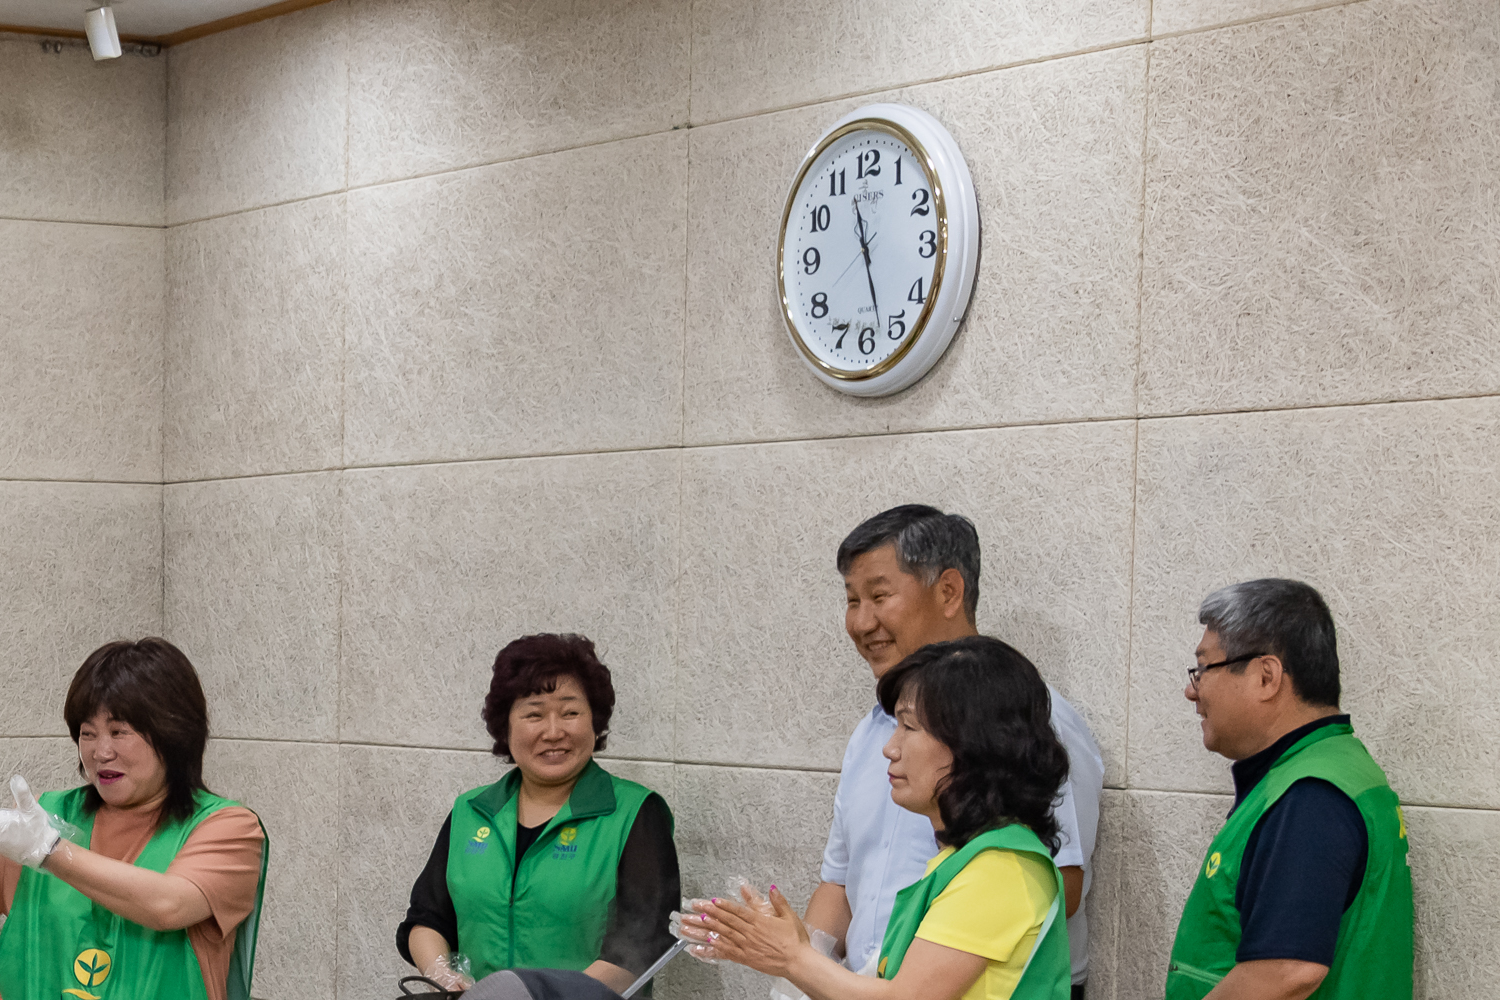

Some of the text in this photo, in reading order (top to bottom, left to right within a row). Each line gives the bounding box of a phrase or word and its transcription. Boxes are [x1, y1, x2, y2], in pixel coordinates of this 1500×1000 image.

[856, 149, 881, 180] 12
[894, 155, 903, 186] 1
[829, 167, 846, 197] 11
[910, 188, 930, 217] 2
[810, 204, 831, 233] 10
[918, 230, 937, 258] 3
[803, 247, 821, 275] 9
[907, 277, 927, 305] 4
[811, 292, 829, 319] 8
[831, 322, 850, 349] 7
[888, 309, 906, 340] 5
[858, 327, 876, 355] 6
